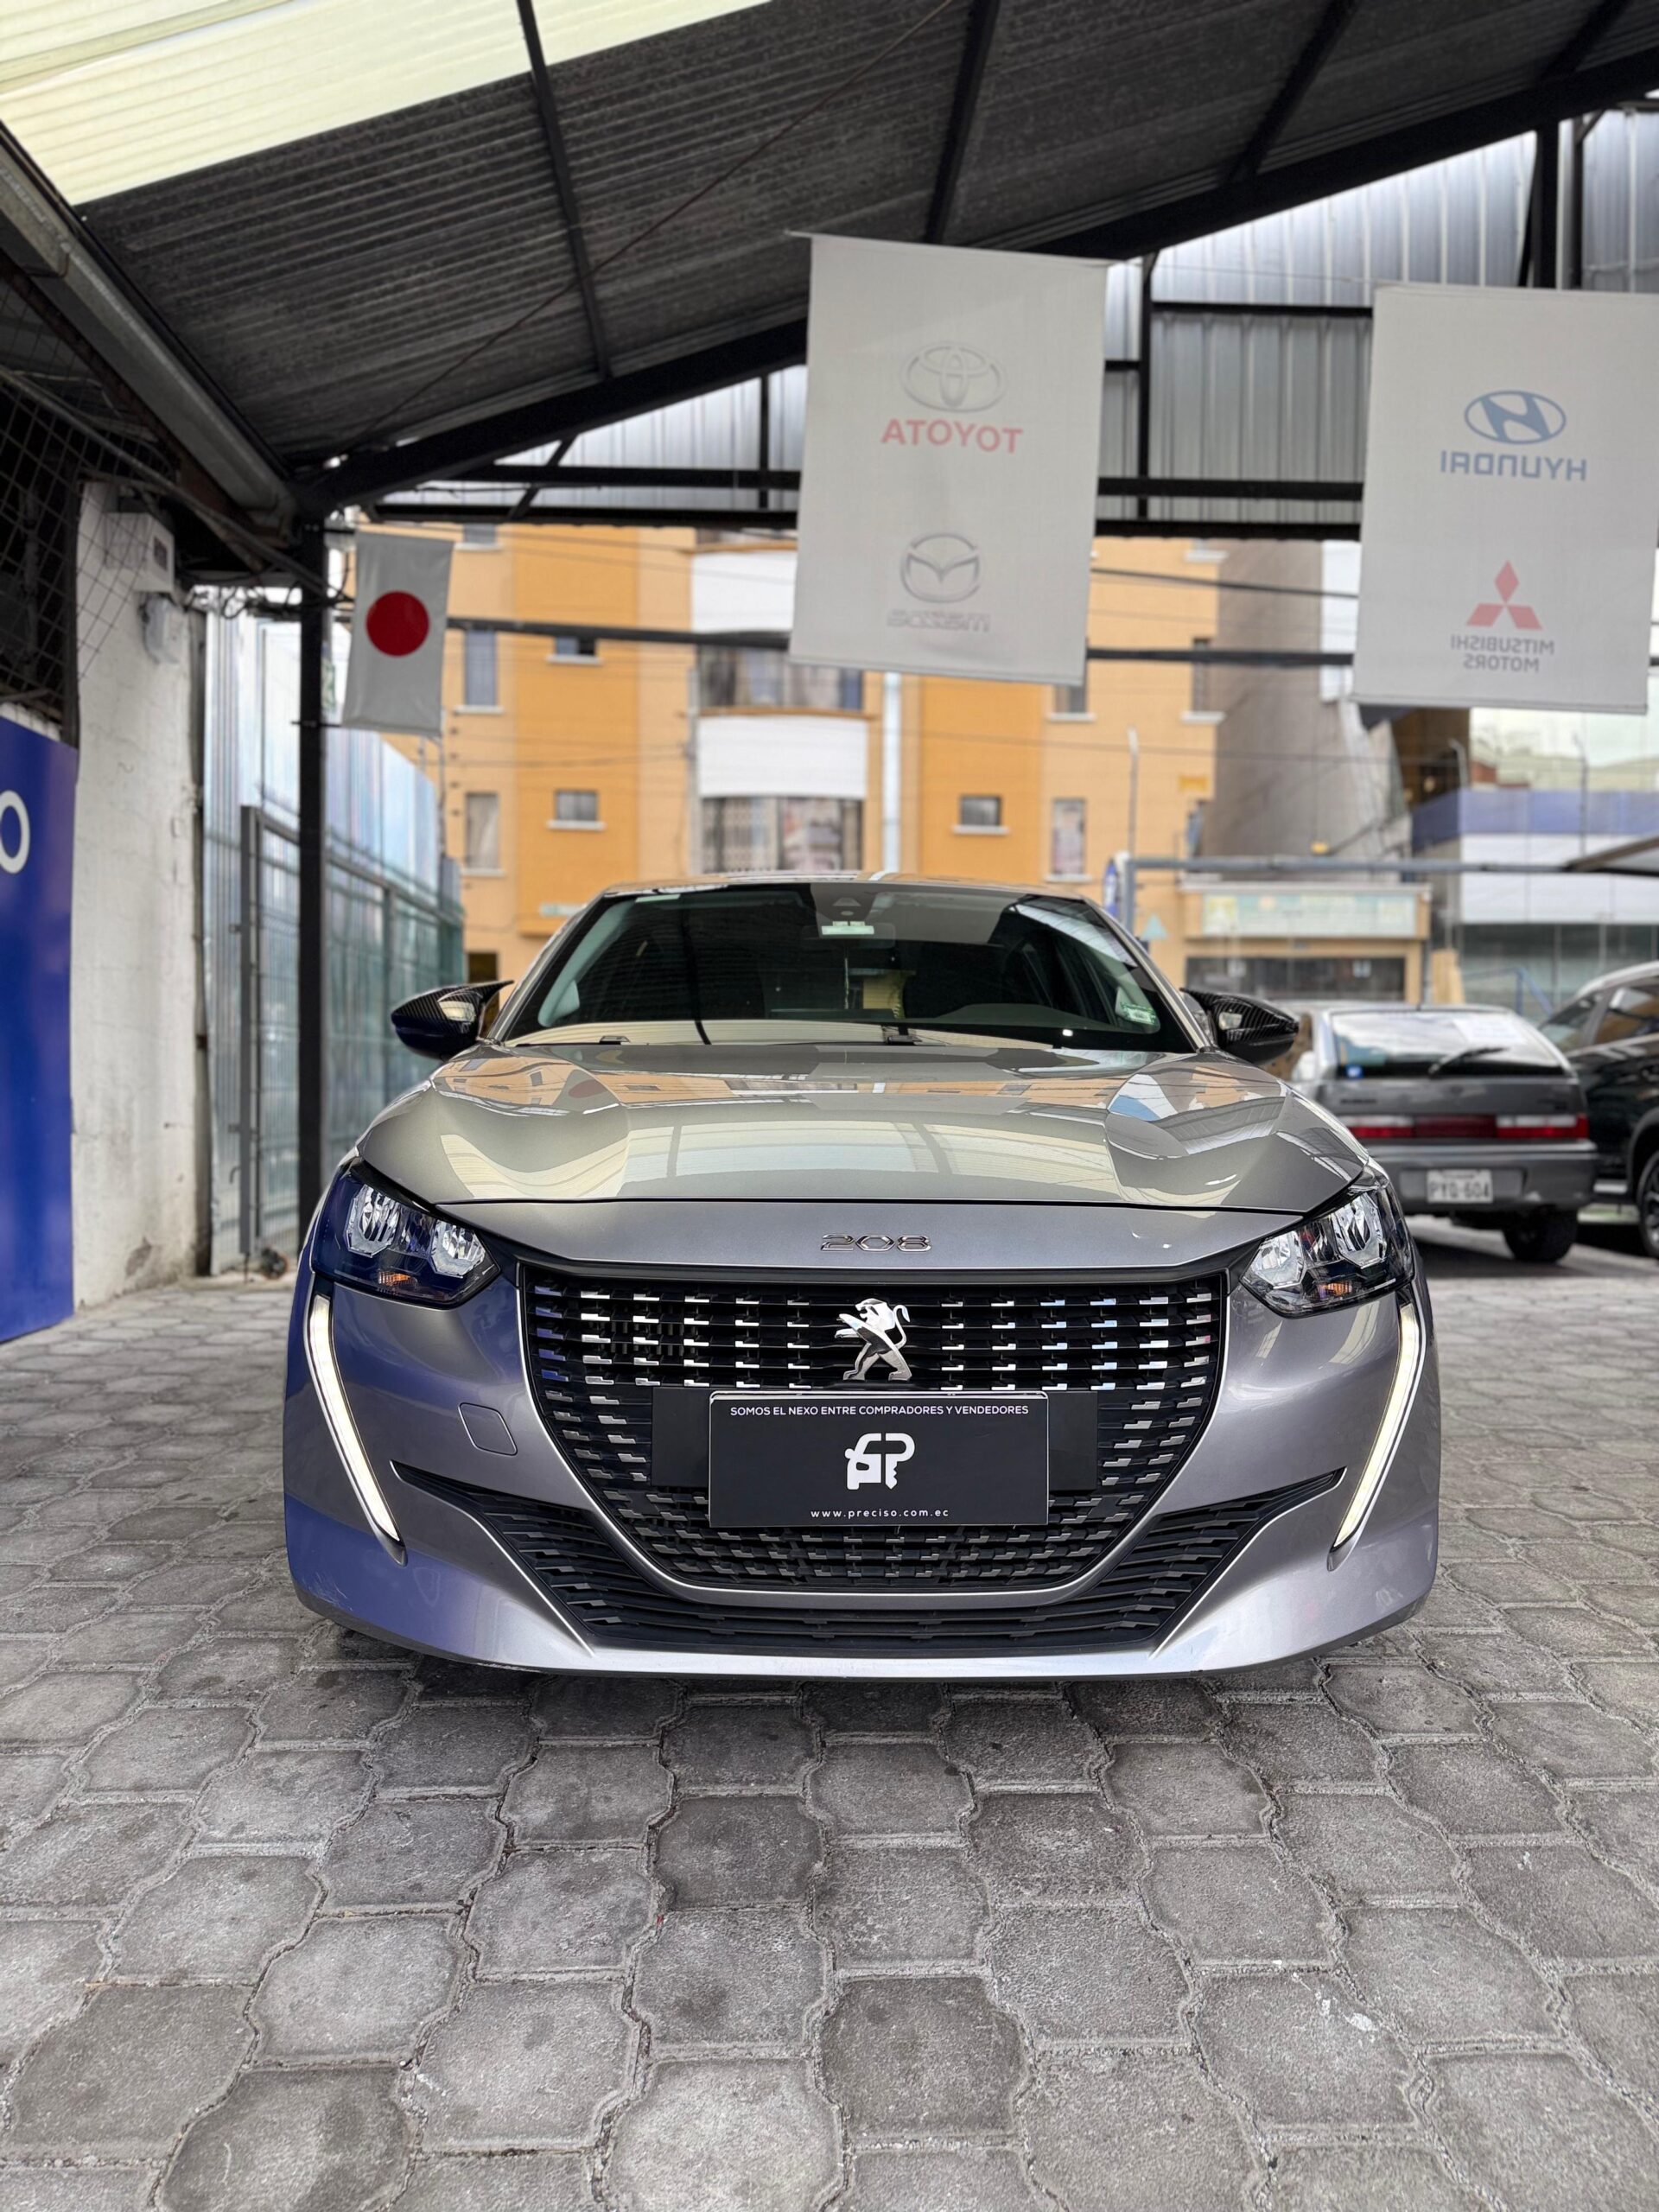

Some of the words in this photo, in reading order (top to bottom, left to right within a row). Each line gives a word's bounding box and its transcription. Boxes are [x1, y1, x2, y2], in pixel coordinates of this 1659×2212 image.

[820, 1233, 932, 1252] 208
[730, 1406, 771, 1416] SOMOS
[772, 1406, 787, 1415] EL
[788, 1406, 819, 1415] NEXO
[821, 1406, 857, 1415] ENTRE
[858, 1406, 944, 1415] COMPRADORES
[945, 1405, 954, 1414] Y
[954, 1405, 1030, 1414] VENDEDORES
[810, 1508, 950, 1522] www.preciso.com.ec
